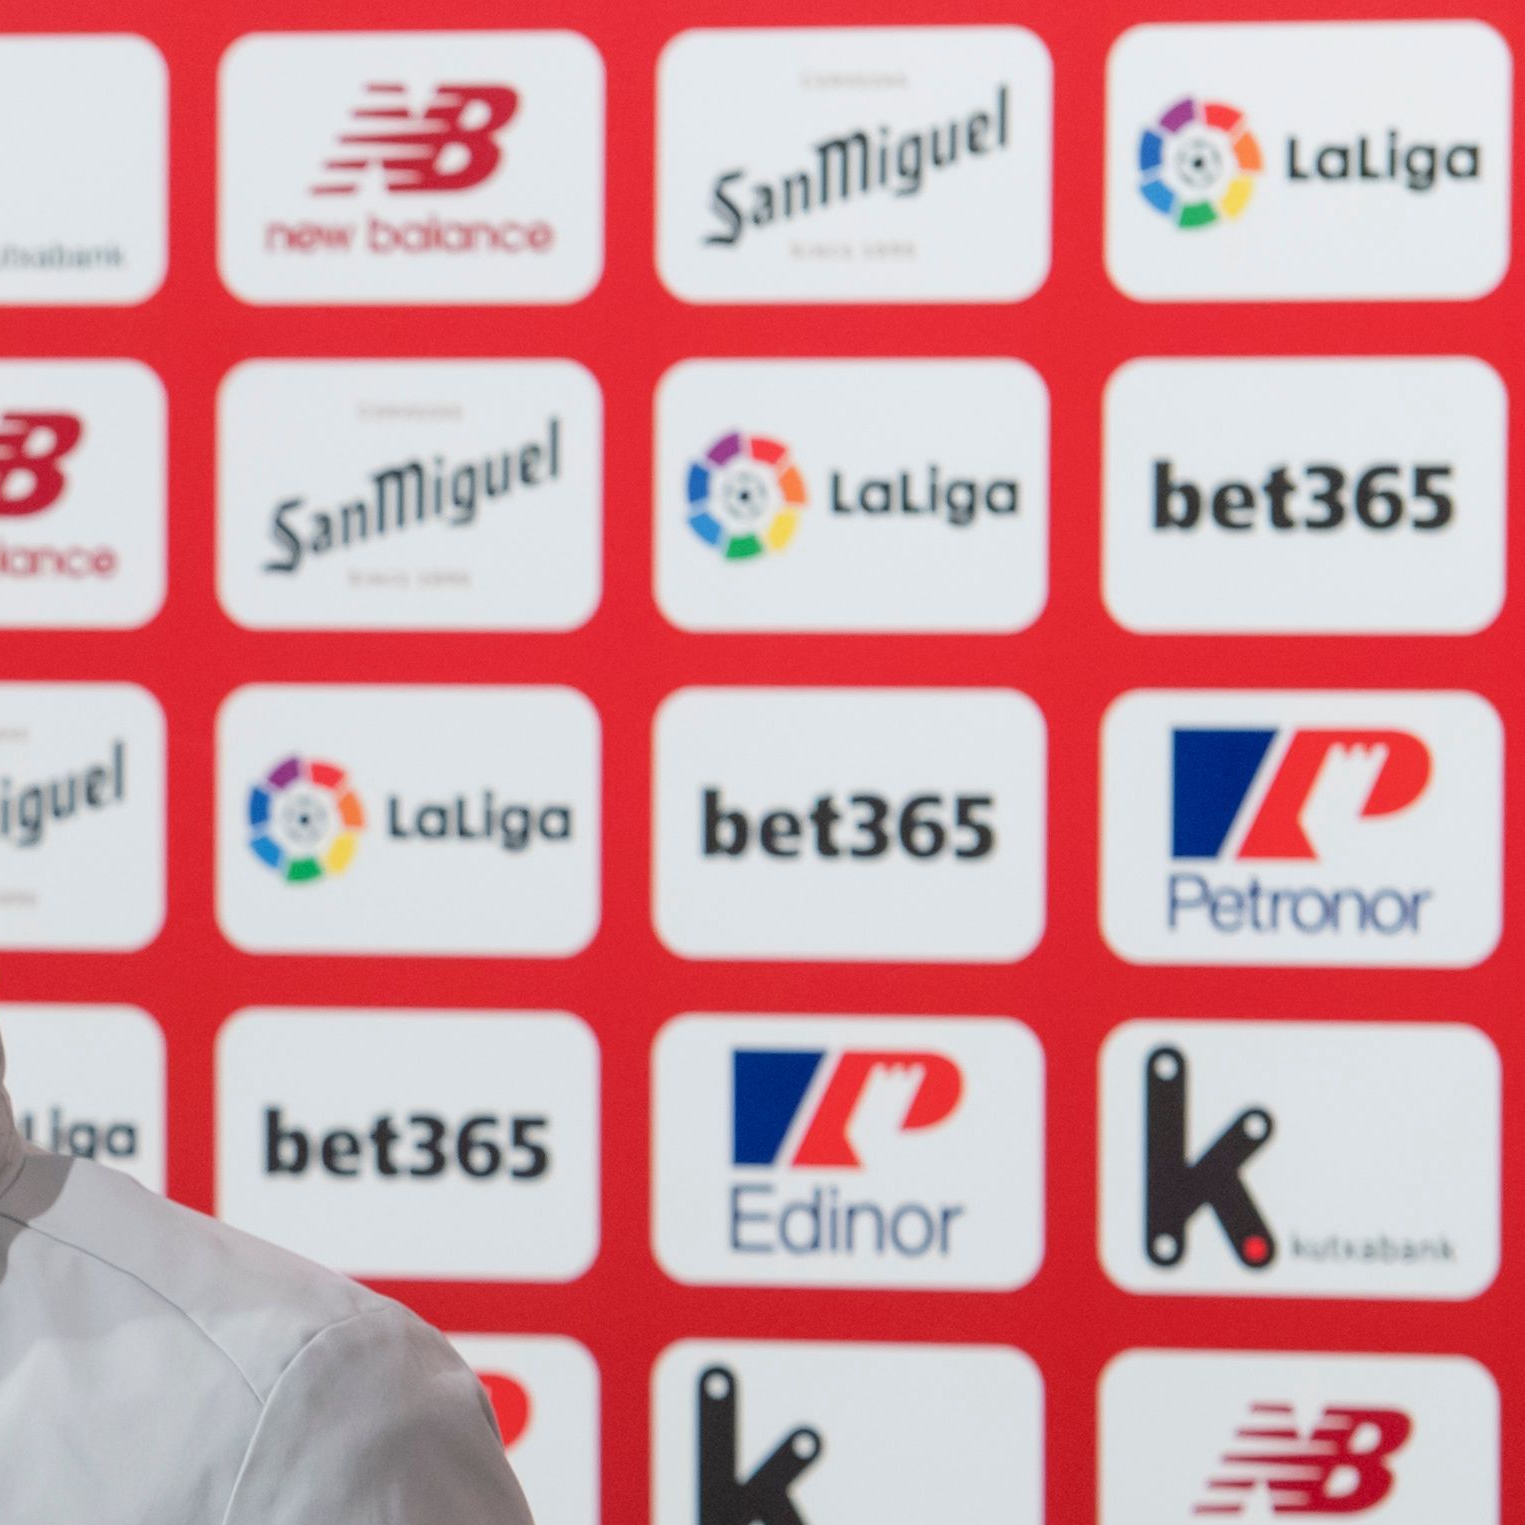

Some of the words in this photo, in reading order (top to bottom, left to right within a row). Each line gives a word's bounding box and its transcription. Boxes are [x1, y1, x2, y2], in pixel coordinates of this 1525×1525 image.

[702, 84, 1015, 248] SanMiguel
[1286, 130, 1481, 194] LaLiga
[265, 222, 355, 254] new
[367, 216, 555, 255] balance
[261, 418, 564, 574] SanMiguel
[830, 465, 1019, 528] LaLiga
[1151, 459, 1455, 533] bet365
[387, 790, 572, 853] LaLiga
[701, 787, 996, 862] bet365
[1167, 872, 1431, 935] Petronor
[263, 1106, 550, 1182] bet365
[728, 1182, 964, 1258] Edinor
